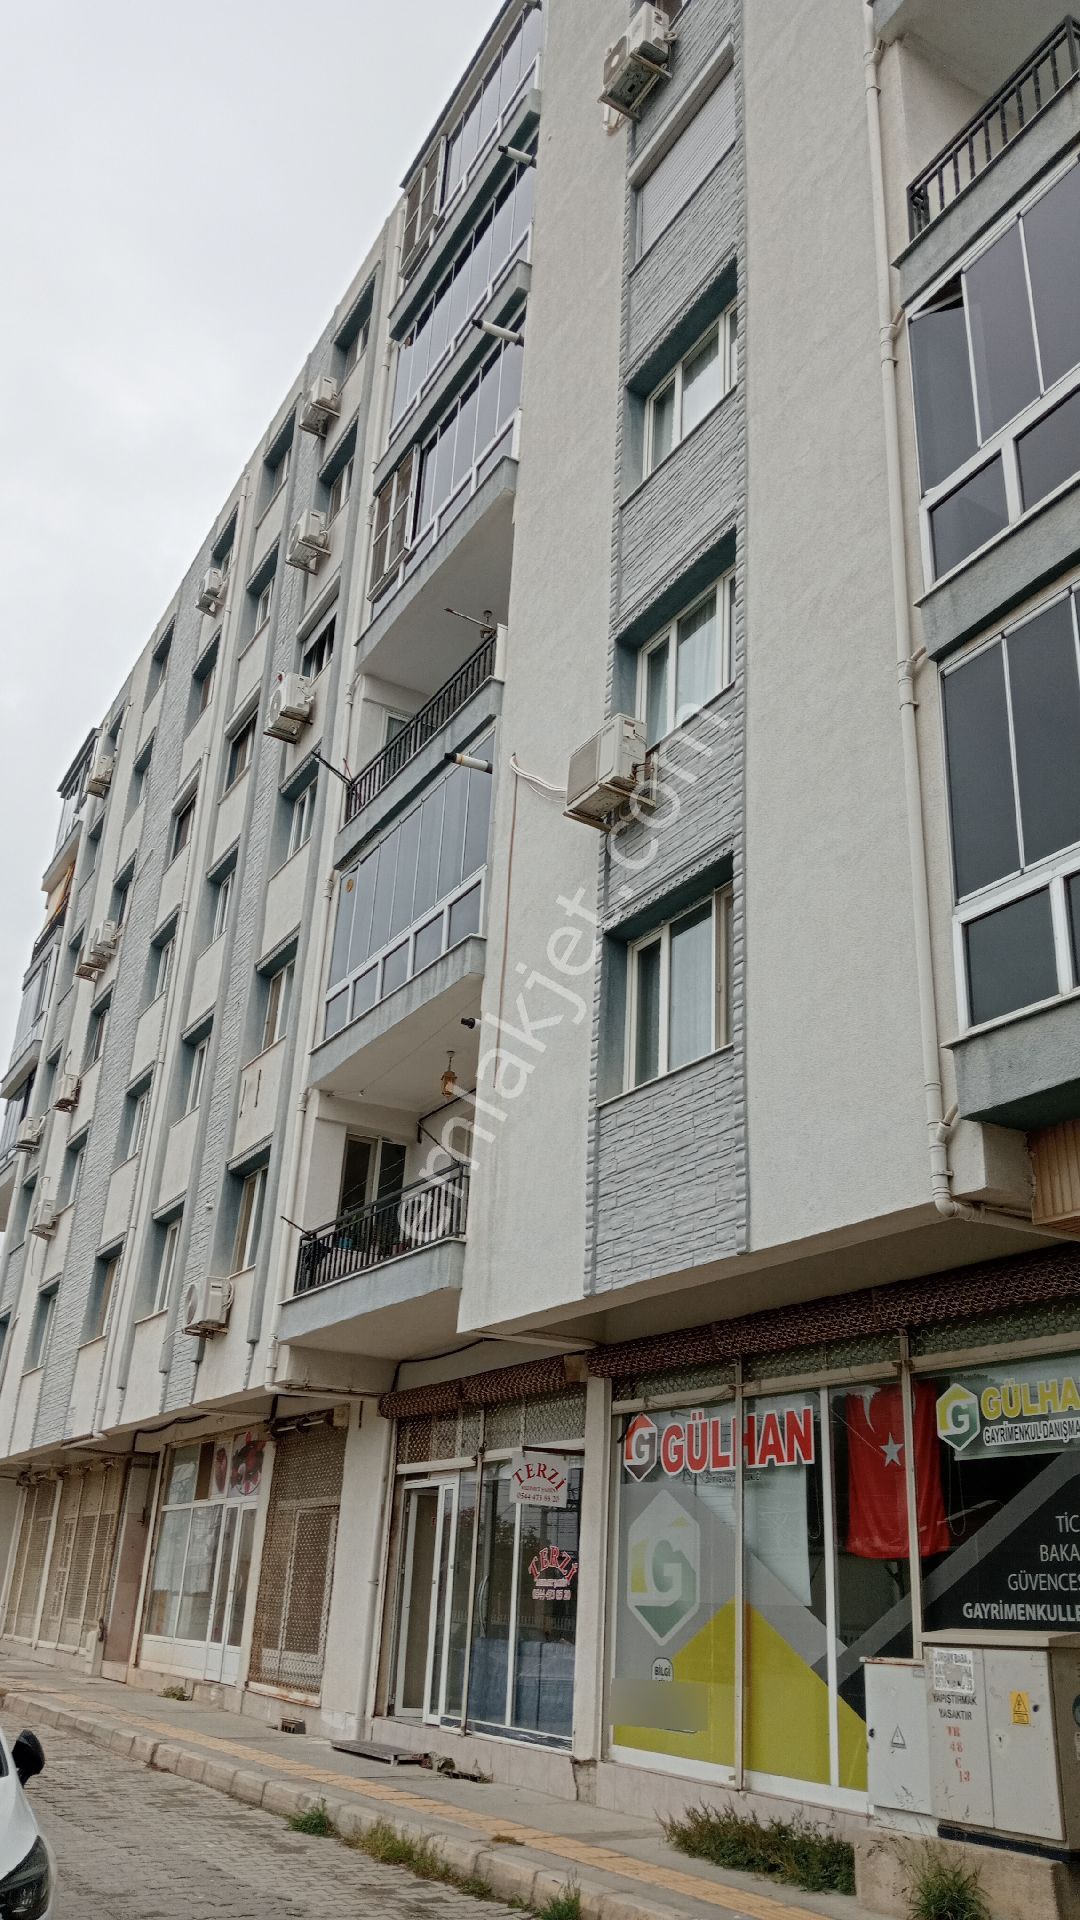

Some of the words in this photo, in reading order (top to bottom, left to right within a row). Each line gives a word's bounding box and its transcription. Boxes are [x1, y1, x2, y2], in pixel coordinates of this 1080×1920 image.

[661, 1406, 815, 1476] GÜLHAN
[984, 1422, 1040, 1445] GAYRİMENKUL
[938, 1708, 972, 1721] YASAKTIR
